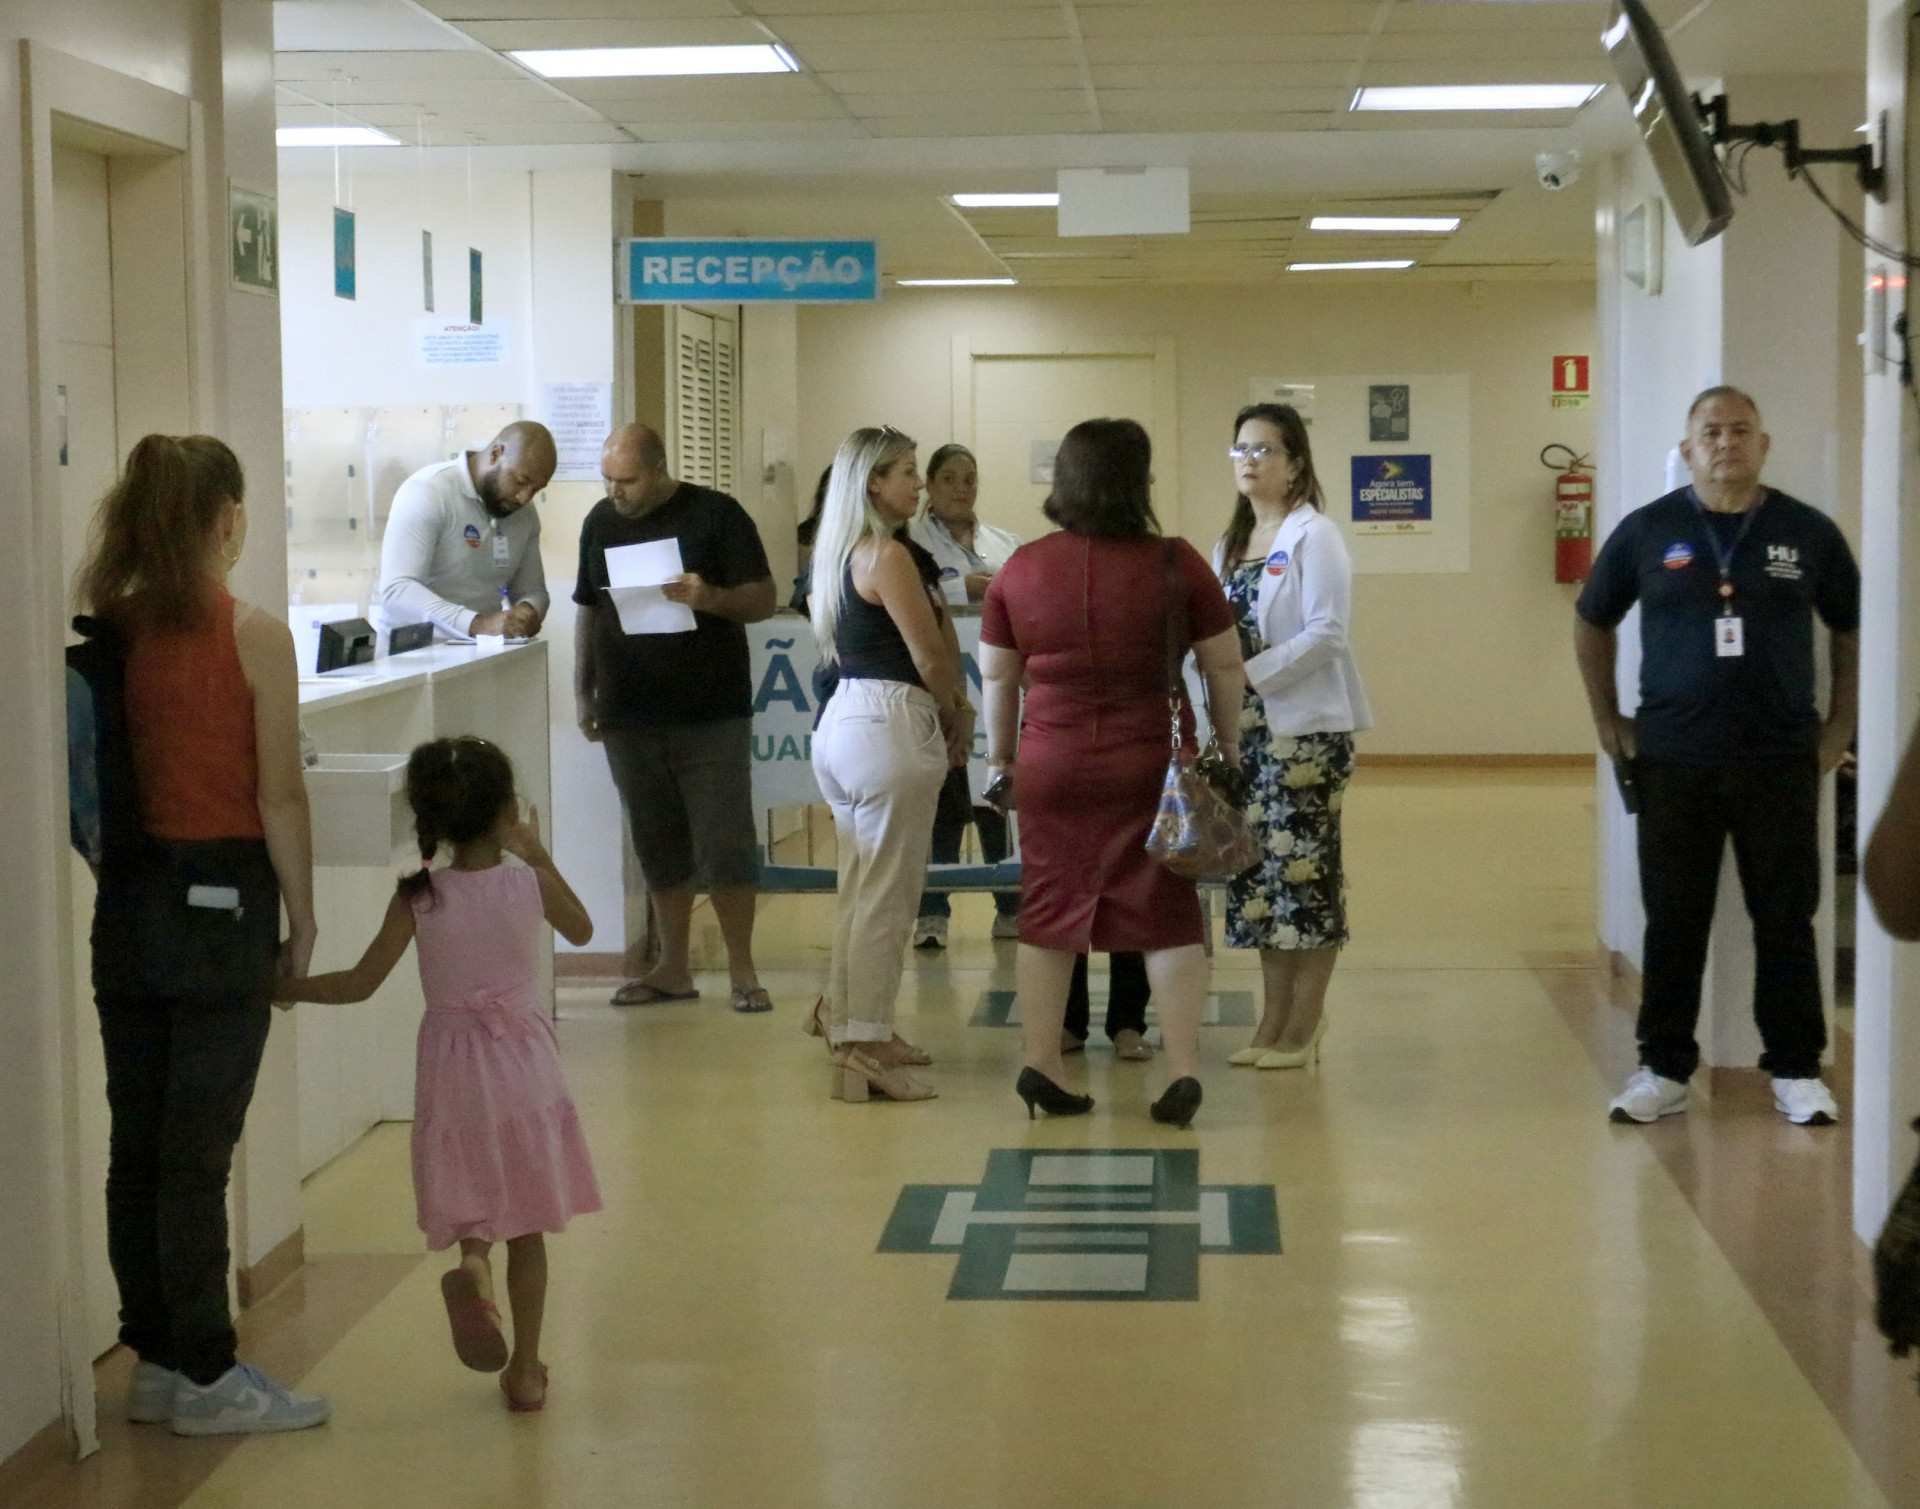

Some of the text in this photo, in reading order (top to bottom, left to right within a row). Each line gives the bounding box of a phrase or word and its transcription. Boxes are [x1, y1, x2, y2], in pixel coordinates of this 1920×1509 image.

[642, 250, 863, 291] RECEPÇÃO
[1369, 479, 1396, 489] Agora
[1359, 487, 1424, 501] ESPECIALISTAS
[1766, 545, 1799, 562] HU
